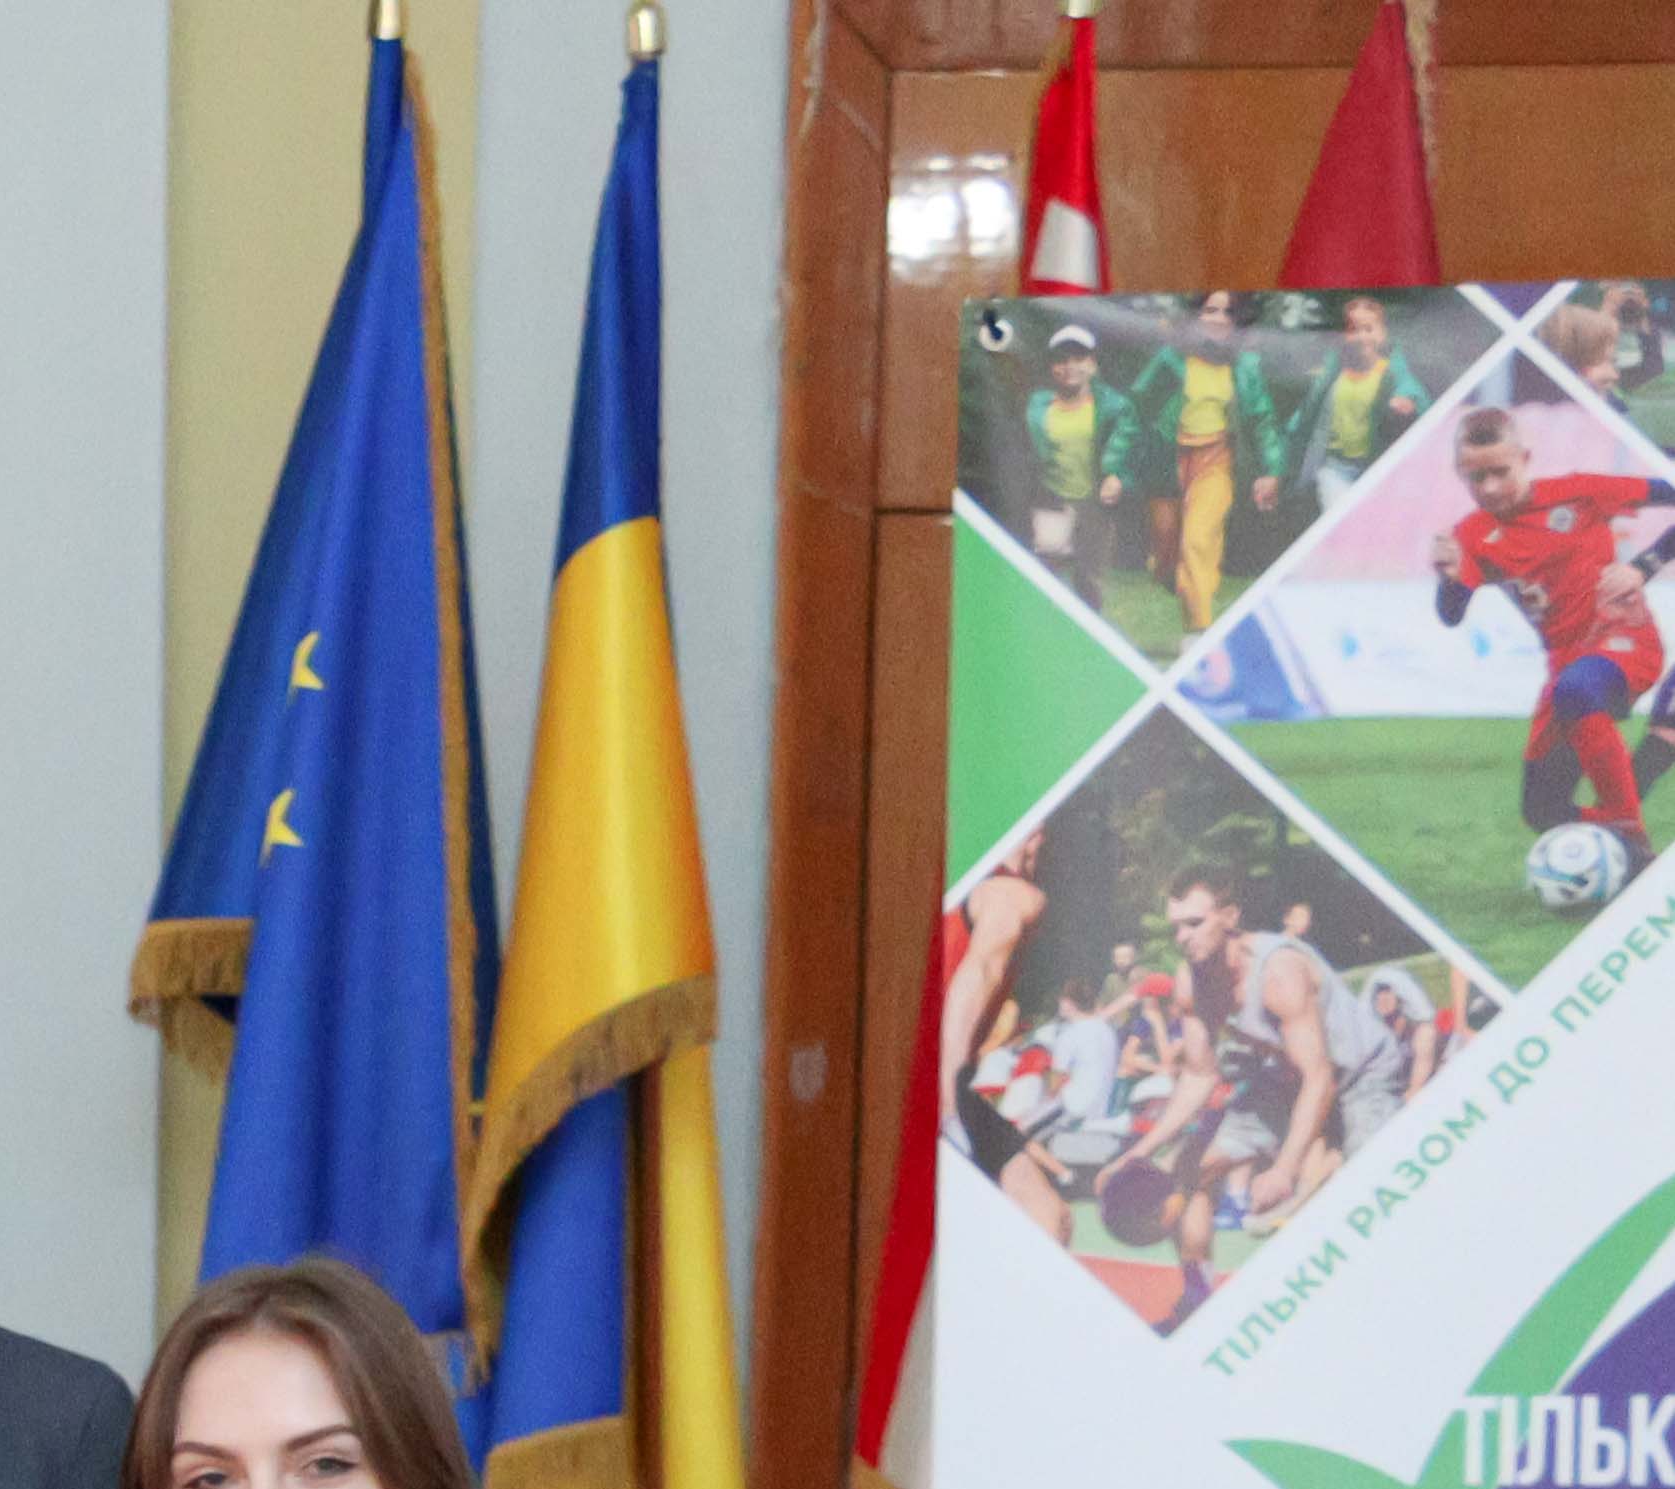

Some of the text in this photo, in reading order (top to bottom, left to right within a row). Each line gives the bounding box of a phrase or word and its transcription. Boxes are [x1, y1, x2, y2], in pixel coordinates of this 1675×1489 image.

[1202, 1238, 1349, 1377] ТІЛЬКИ
[1346, 1100, 1488, 1240] РАЗОМ
[1487, 1035, 1551, 1104] ДО
